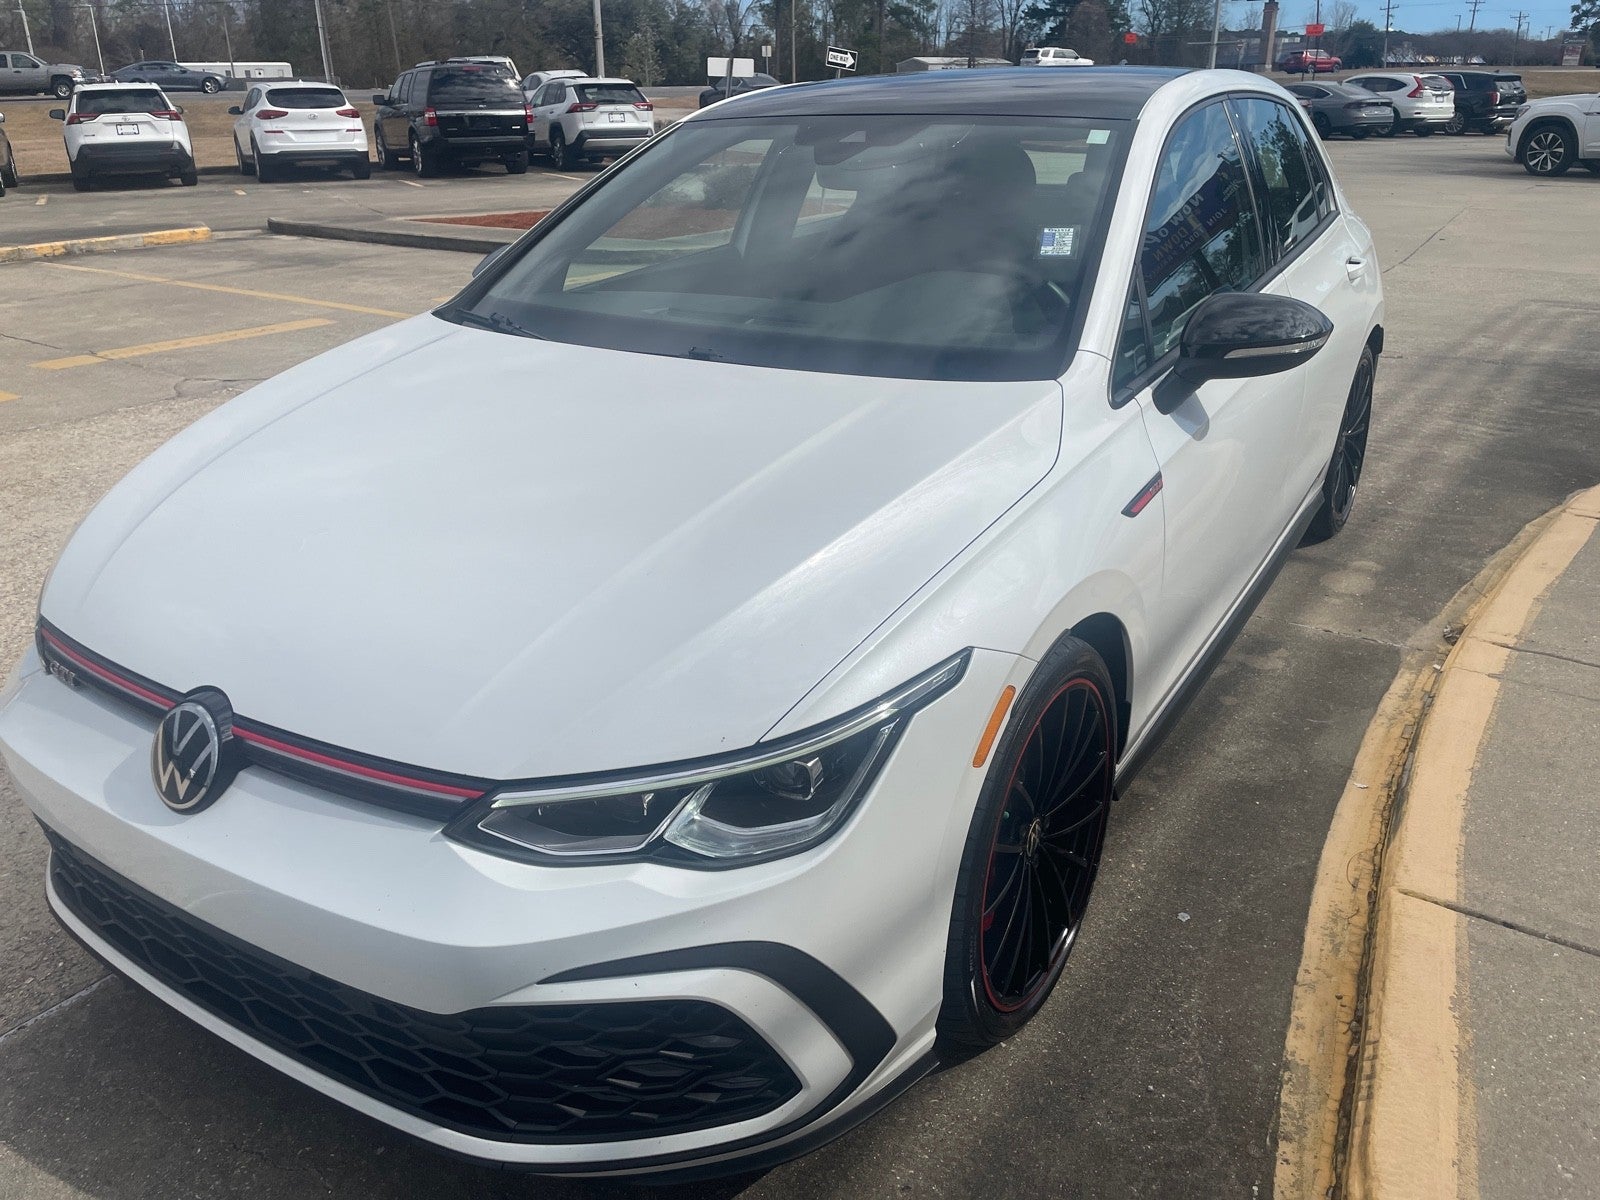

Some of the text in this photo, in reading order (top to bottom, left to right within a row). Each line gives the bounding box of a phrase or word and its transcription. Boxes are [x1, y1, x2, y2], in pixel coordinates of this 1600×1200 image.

[830, 53, 849, 63] ONE WAY
[49, 660, 76, 687] GTI
